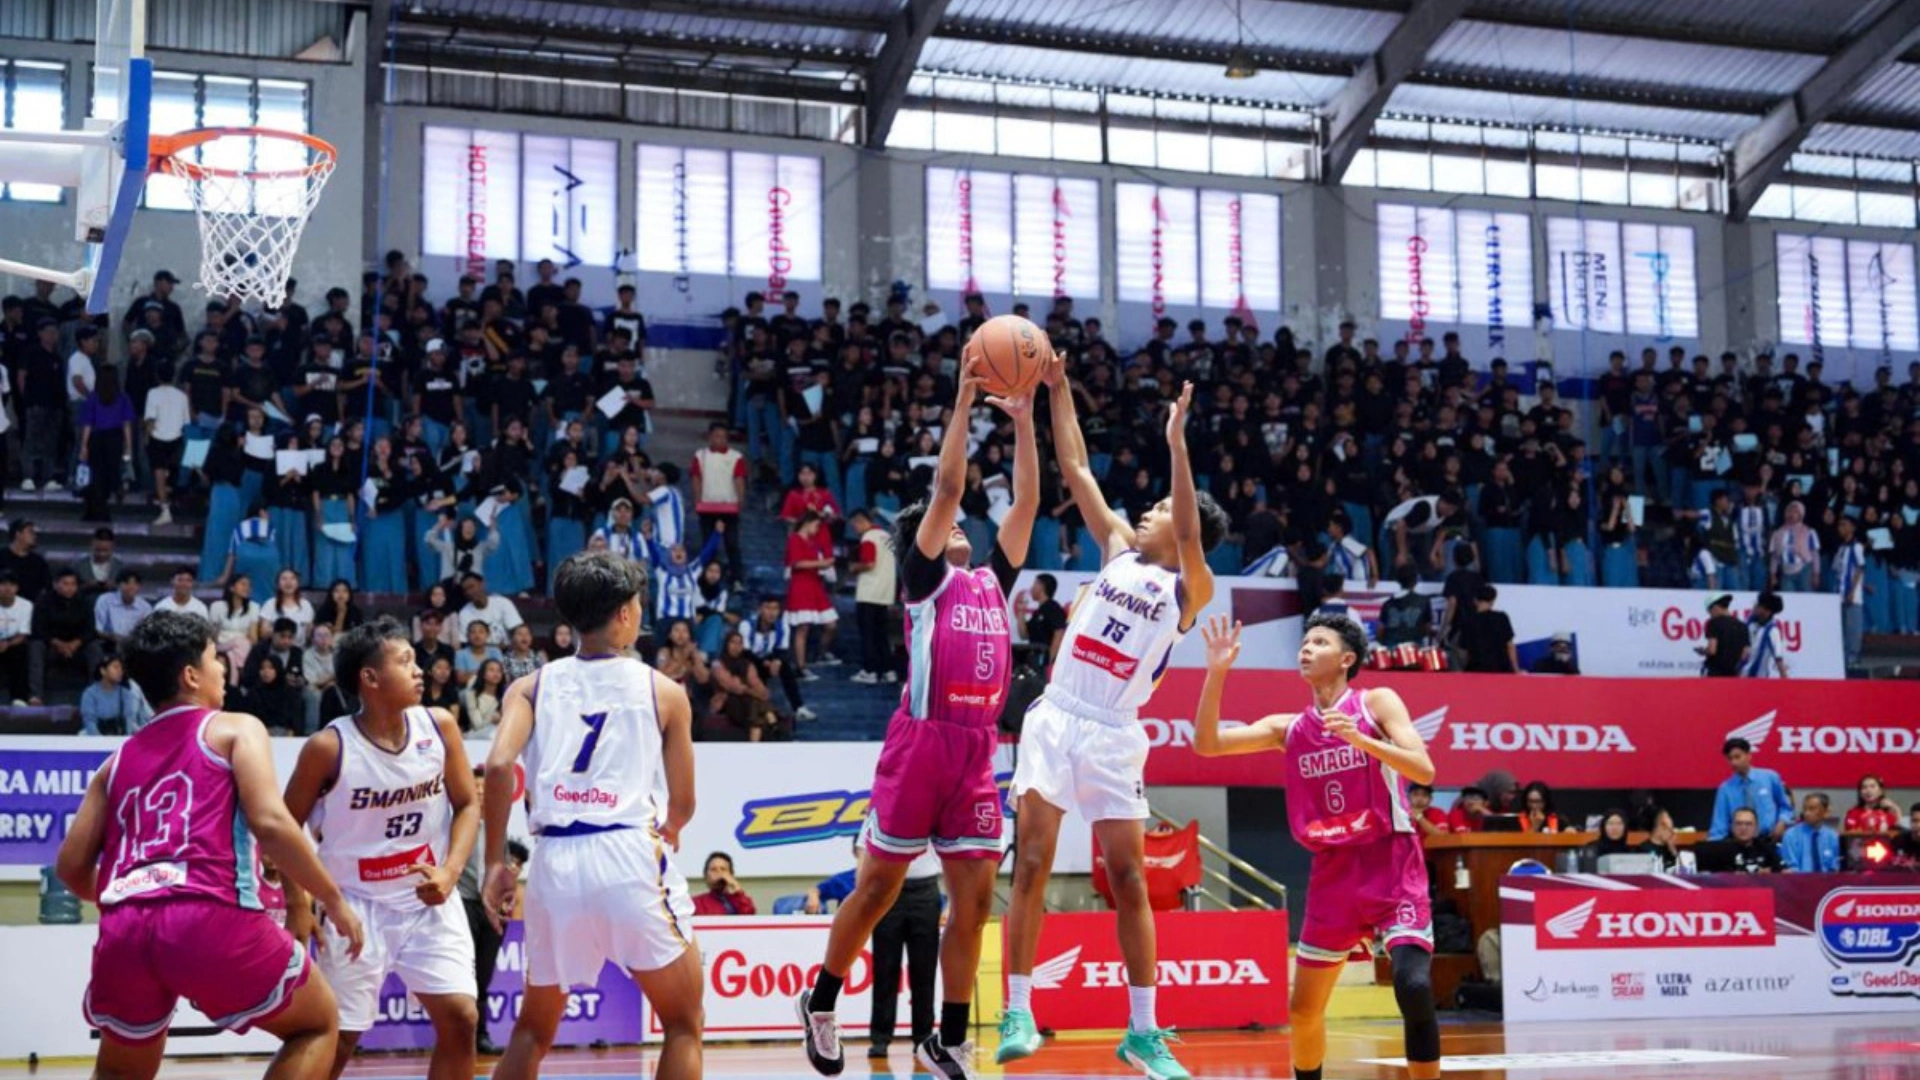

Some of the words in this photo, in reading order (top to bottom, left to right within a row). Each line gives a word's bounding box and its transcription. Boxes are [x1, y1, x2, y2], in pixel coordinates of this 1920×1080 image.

[467, 144, 486, 187] HOT
[976, 641, 995, 680] 5
[1449, 721, 1637, 752] HONDA
[1298, 744, 1368, 779] SMAGA
[1324, 779, 1346, 814] 6
[115, 769, 194, 868] 13
[385, 812, 423, 840] 53
[974, 801, 995, 834] 5
[1596, 911, 1768, 938] HONDA
[1857, 928, 1893, 948] DBL
[1655, 972, 1692, 985] ULTRA
[1660, 985, 1690, 997] MILK
